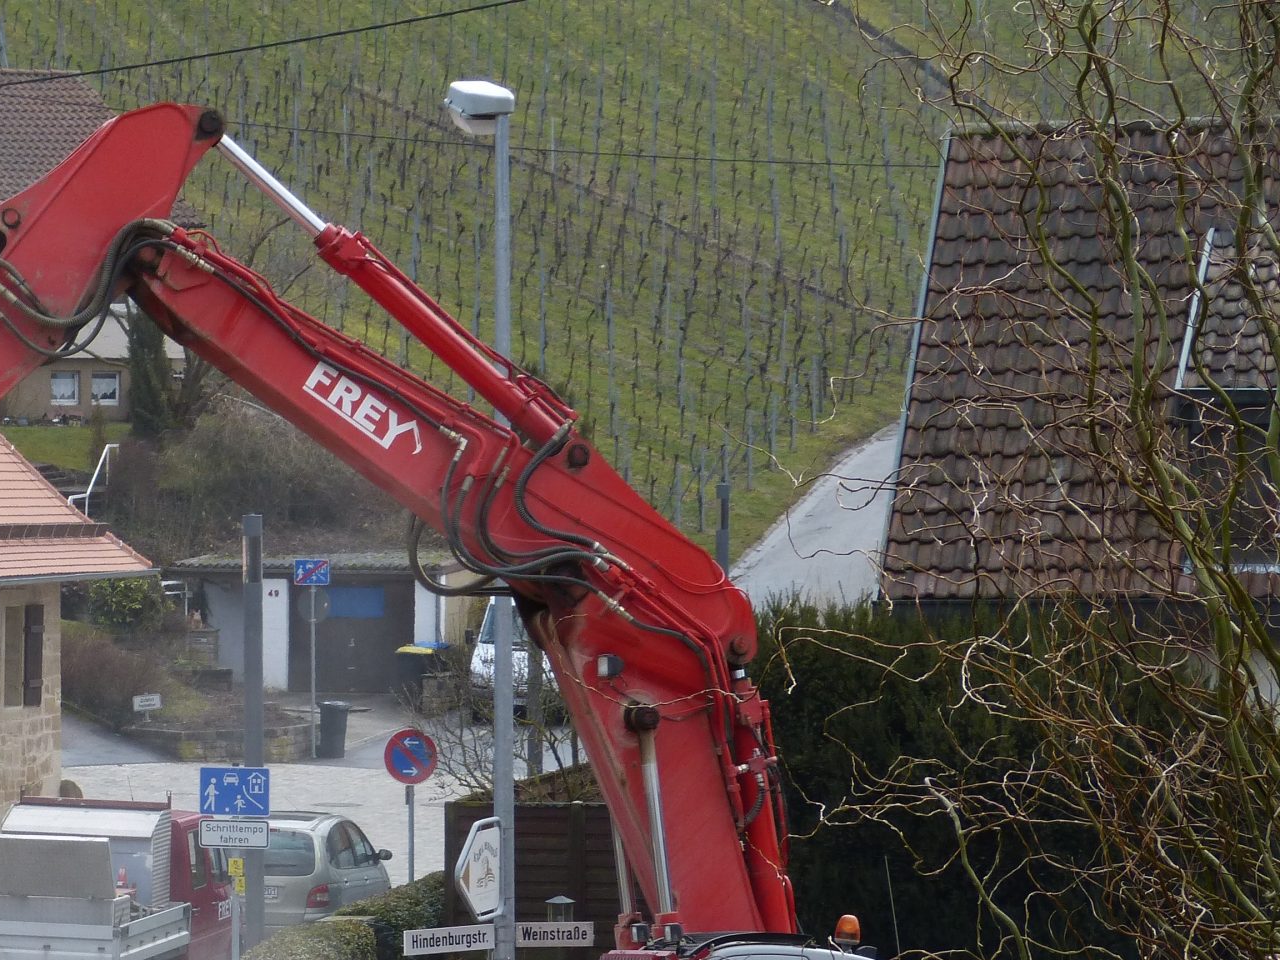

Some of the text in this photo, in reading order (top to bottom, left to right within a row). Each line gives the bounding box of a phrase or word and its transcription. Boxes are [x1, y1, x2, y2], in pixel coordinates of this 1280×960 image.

[304, 361, 418, 450] FREY
[220, 835, 249, 844] fahren
[411, 930, 489, 949] Hindenburgstr.
[521, 926, 588, 941] Weinstraße
